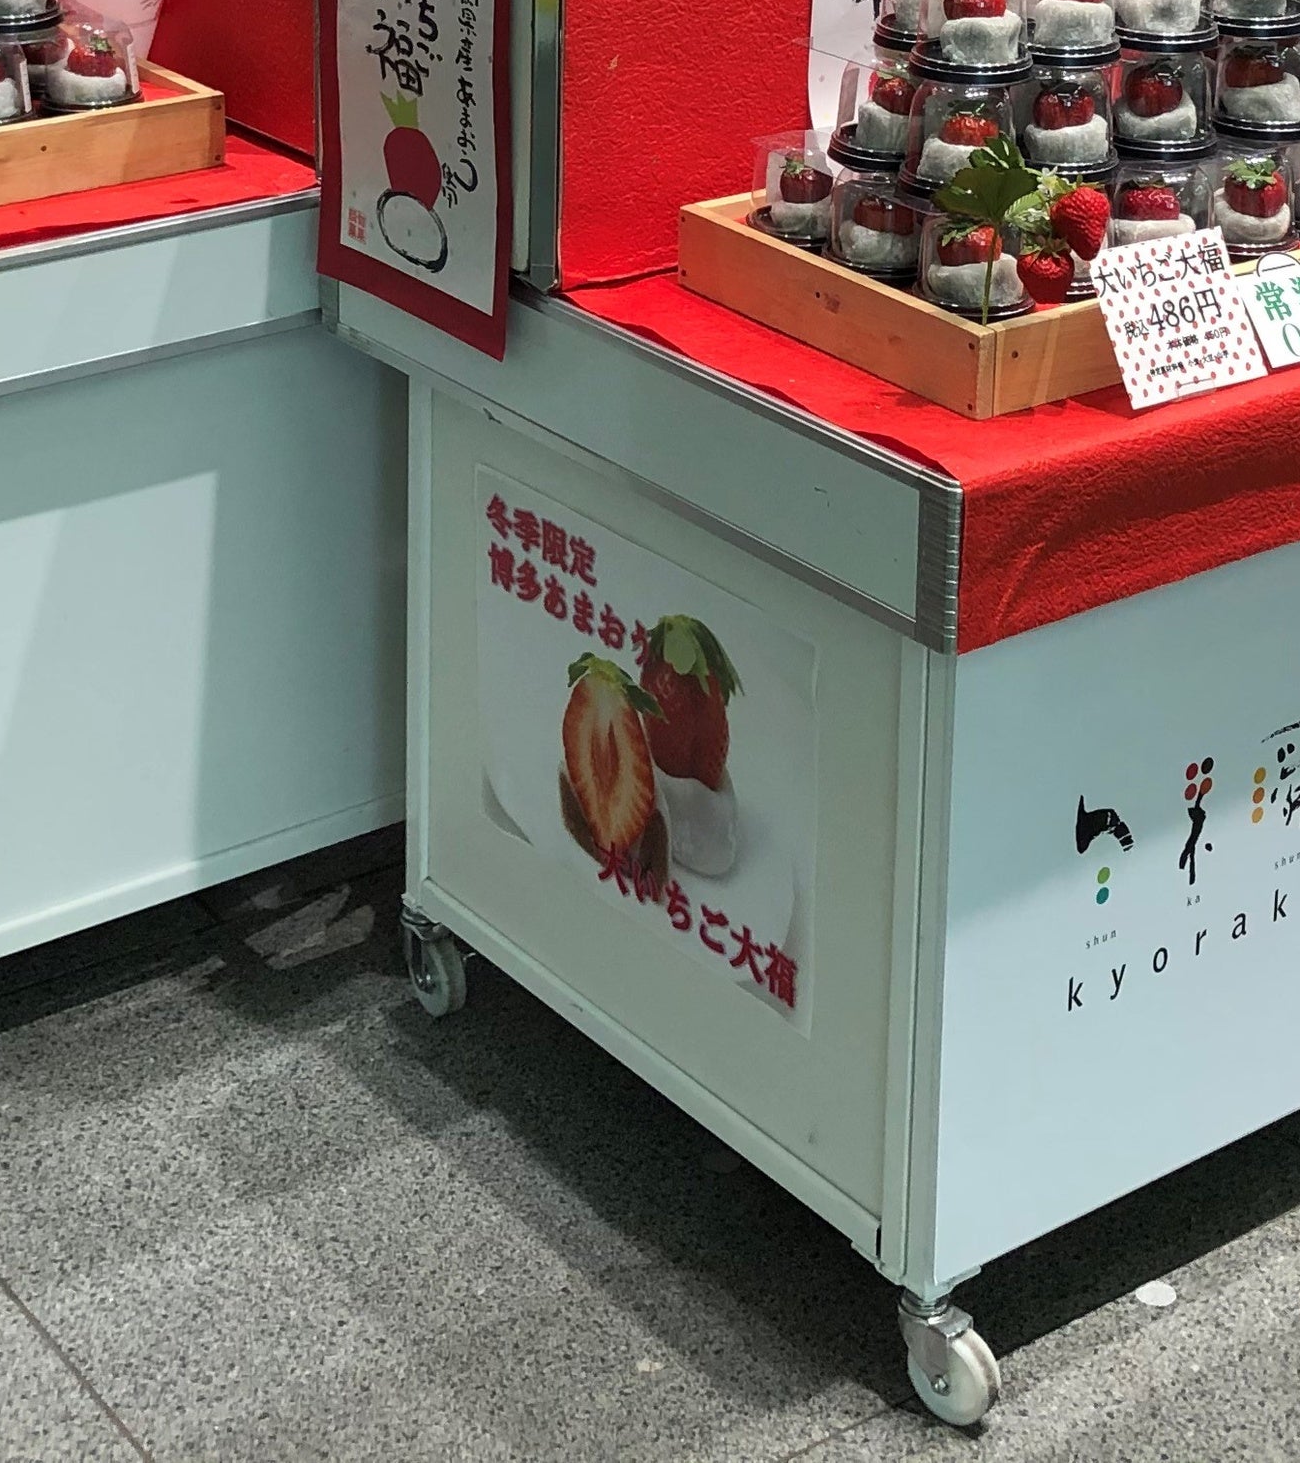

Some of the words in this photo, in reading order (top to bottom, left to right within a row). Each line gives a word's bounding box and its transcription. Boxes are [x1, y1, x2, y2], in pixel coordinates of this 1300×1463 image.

[1094, 242, 1226, 298] 大いちご大福
[1150, 288, 1223, 333] 486円
[486, 493, 598, 587] 冬季限定
[598, 842, 798, 1009] 大いちご大福
[1085, 929, 1118, 950] shun
[1186, 893, 1202, 908] ka
